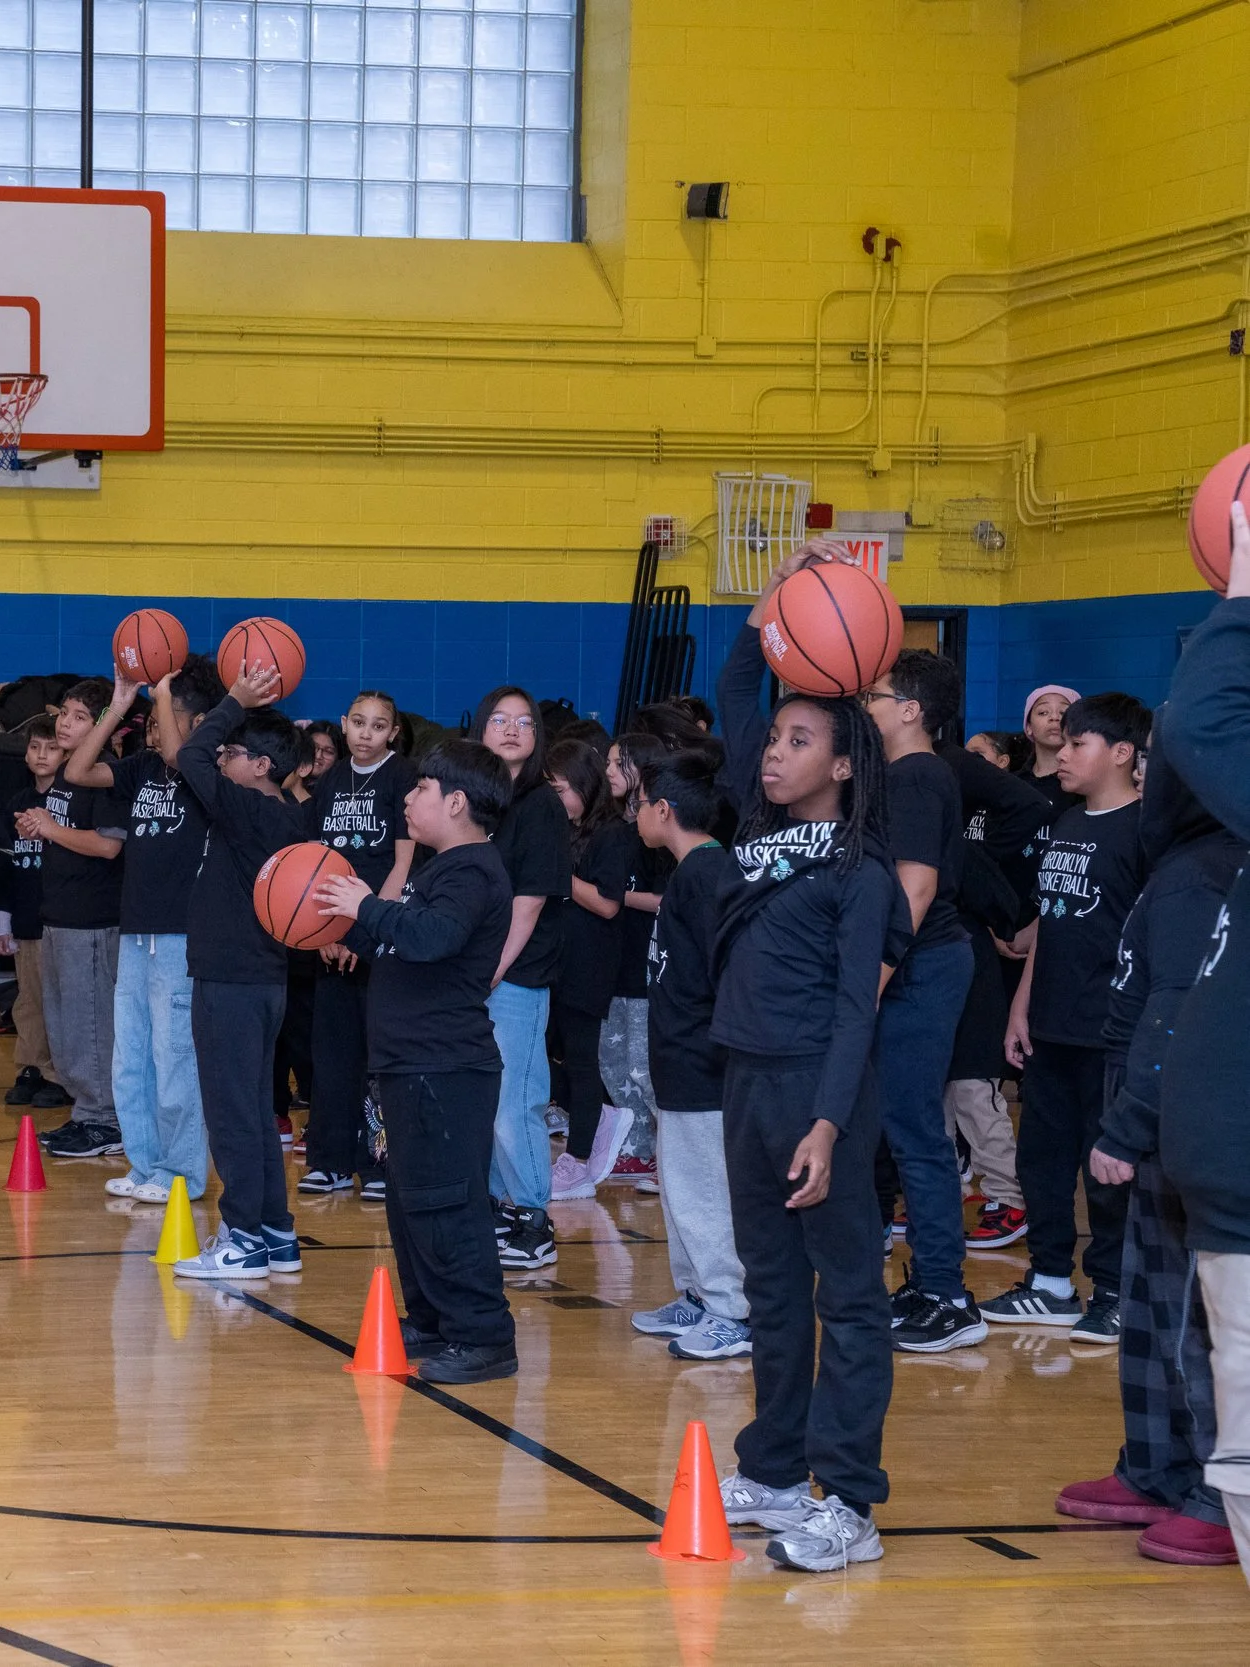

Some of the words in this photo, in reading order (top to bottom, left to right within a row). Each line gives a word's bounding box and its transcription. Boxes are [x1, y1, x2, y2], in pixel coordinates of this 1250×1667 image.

[846, 540, 884, 577] XIT
[331, 799, 373, 817] BROOKLYN
[322, 815, 380, 832] BASKETBALL
[1041, 850, 1091, 875] BROOKLYN
